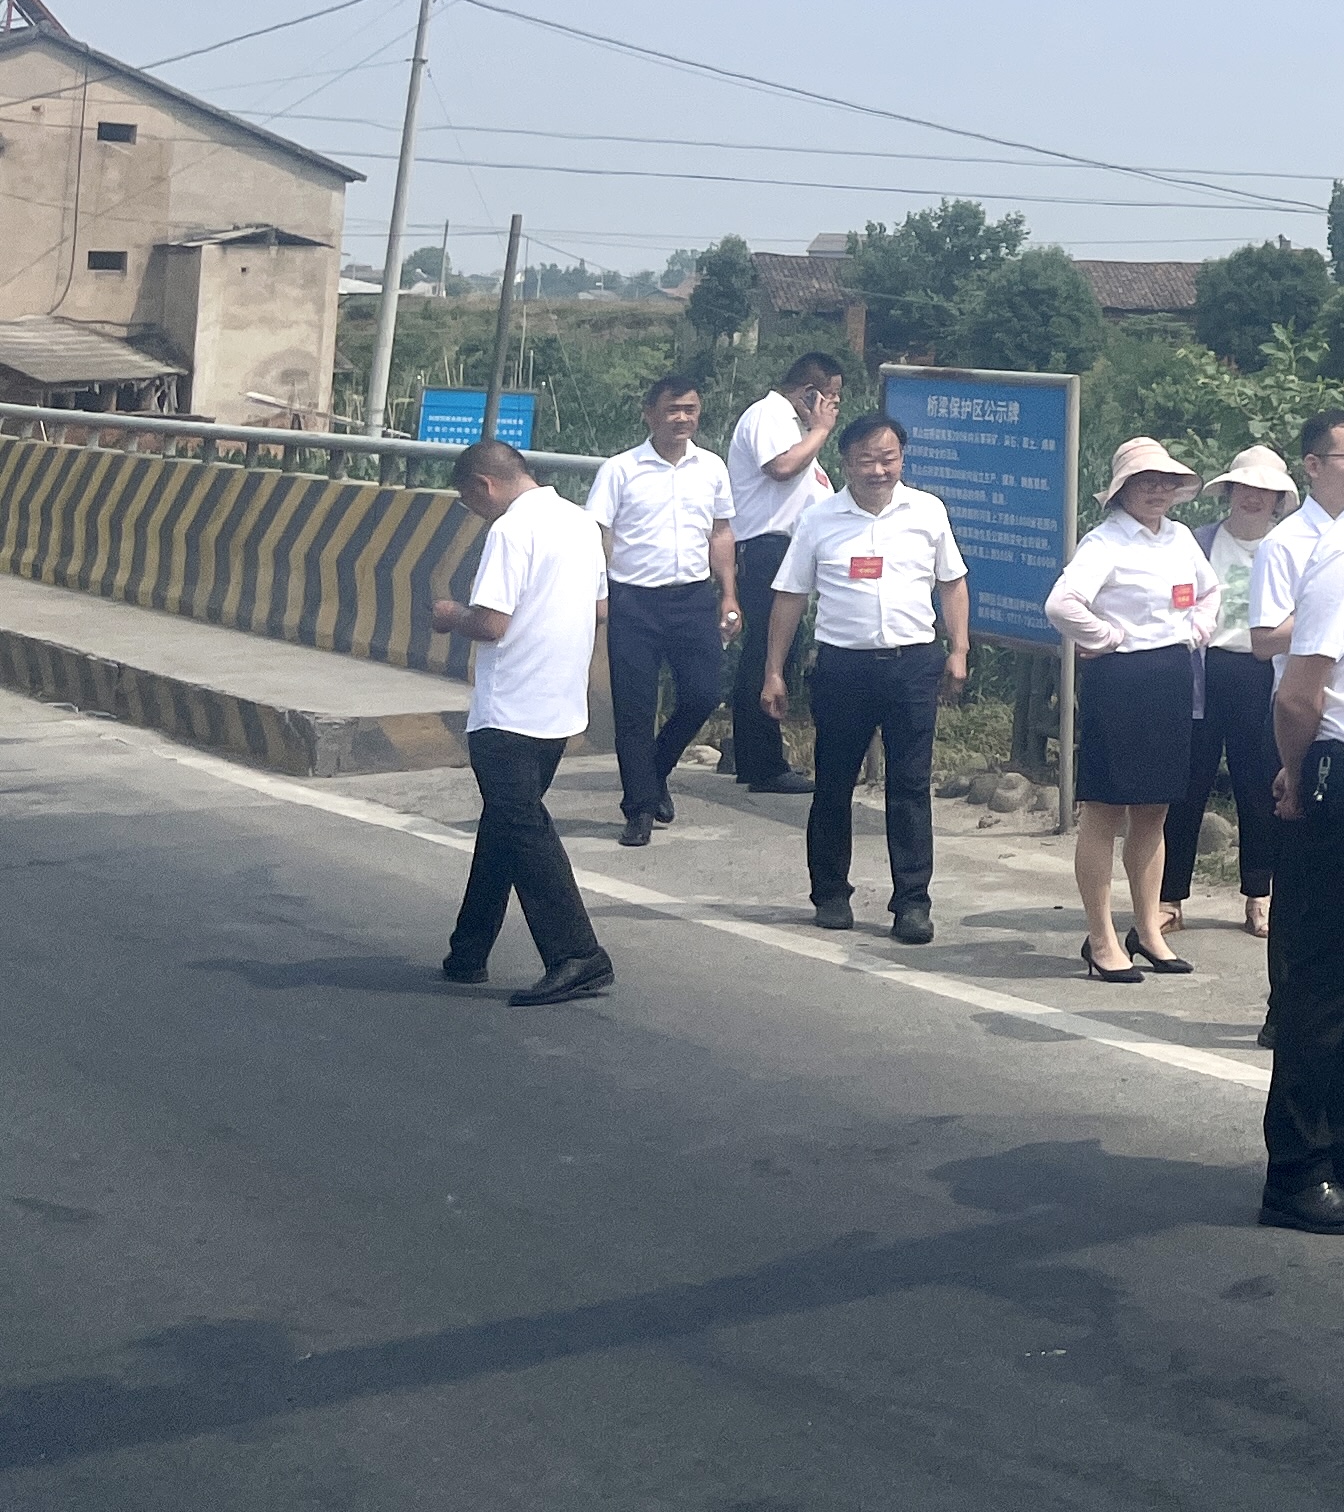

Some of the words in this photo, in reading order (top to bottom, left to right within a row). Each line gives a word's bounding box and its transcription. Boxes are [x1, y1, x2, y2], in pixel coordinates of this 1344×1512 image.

[927, 394, 1020, 425] 桥梁保护区公示牌
